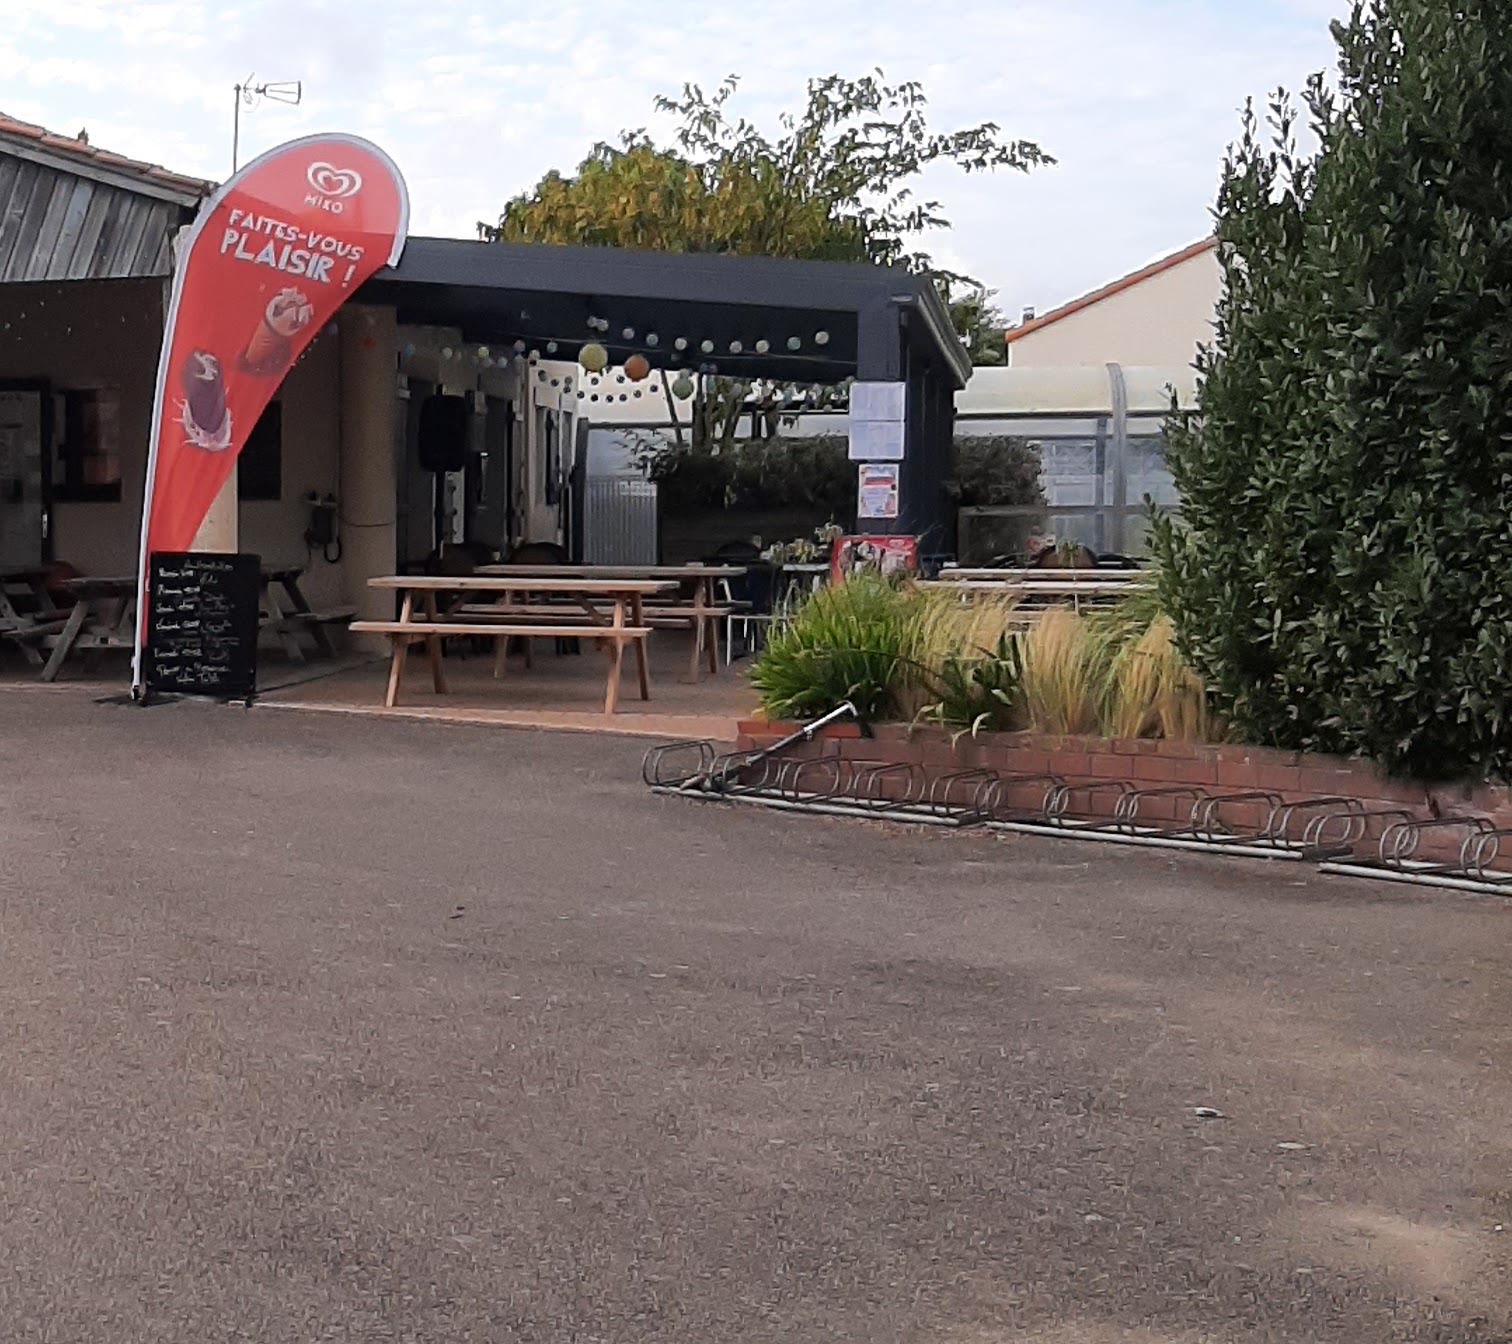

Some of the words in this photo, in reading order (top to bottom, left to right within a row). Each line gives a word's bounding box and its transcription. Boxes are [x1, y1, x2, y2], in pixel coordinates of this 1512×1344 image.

[304, 194, 344, 214] MIKO
[220, 227, 335, 283] PLAISIR
[229, 208, 365, 261] FAITES-VOUS
